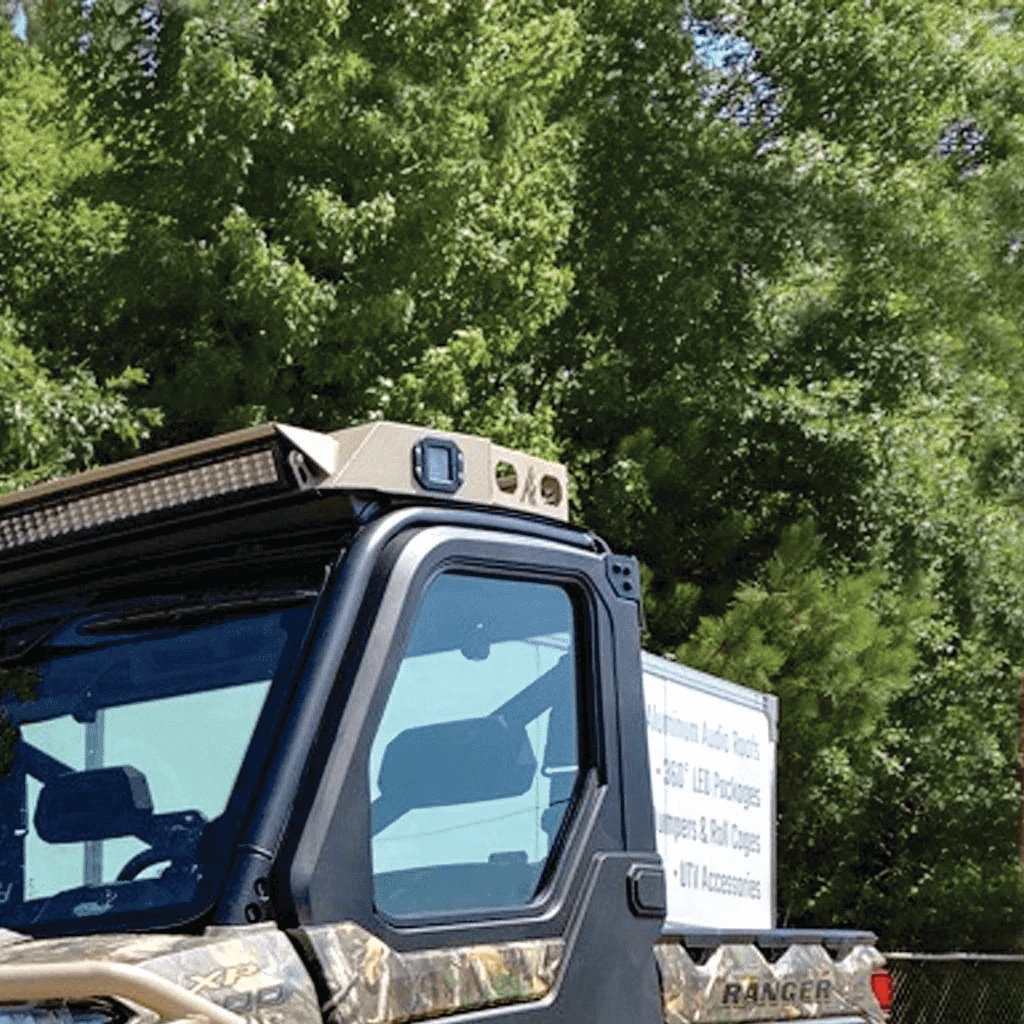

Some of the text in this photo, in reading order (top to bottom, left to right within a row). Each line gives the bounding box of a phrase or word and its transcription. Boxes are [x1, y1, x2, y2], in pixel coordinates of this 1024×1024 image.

[692, 766, 711, 796] LED
[713, 771, 761, 810] Packages
[657, 812, 761, 858] umpers & Roll Cages
[679, 860, 761, 900] UTV Accessories
[181, 961, 261, 994] XP
[722, 979, 832, 1005] RANGER
